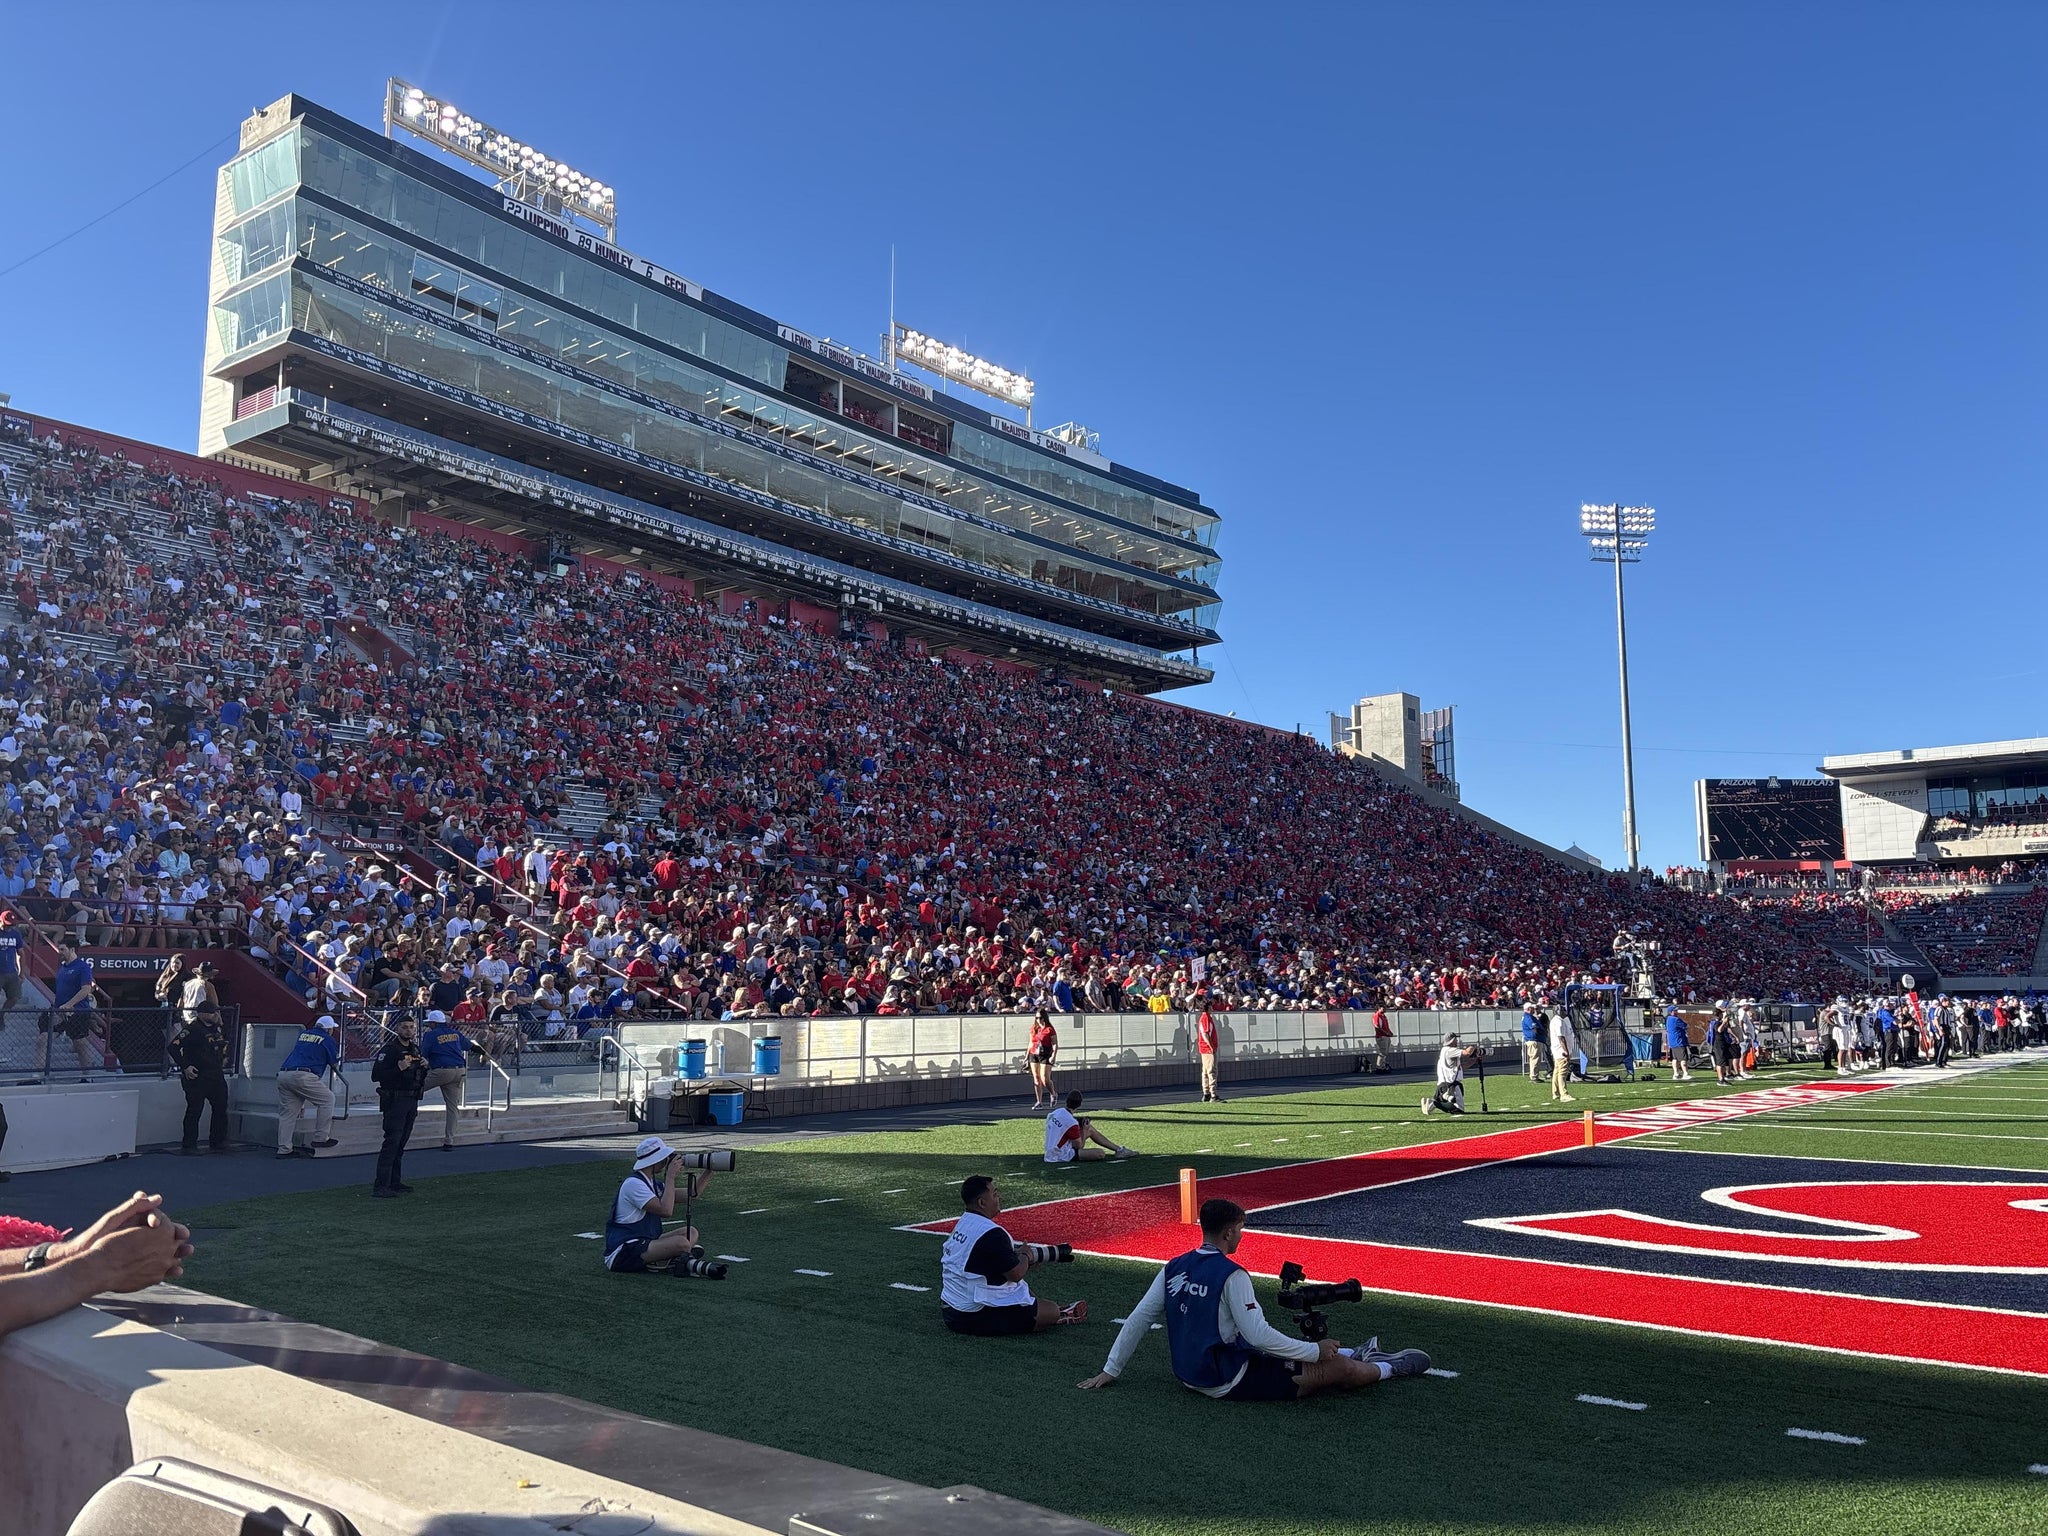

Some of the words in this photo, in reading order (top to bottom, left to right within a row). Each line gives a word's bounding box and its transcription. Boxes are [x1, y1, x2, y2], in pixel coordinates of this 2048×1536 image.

[507, 201, 522, 217] 22
[523, 209, 570, 241] LUPPINO
[578, 235, 593, 251] 89
[595, 241, 634, 270] HUNLEY
[314, 264, 334, 278] ROB
[335, 272, 393, 302] GRONKOWSKI
[646, 265, 654, 280] 6
[664, 274, 689, 297] CECIL
[396, 298, 429, 317] SCOOBY
[430, 311, 461, 329] WRIGHT
[465, 325, 492, 342] TRUNG
[491, 335, 528, 355] CANIDATE
[781, 328, 787, 339] 4
[791, 332, 812, 351] LEWIS
[312, 337, 330, 350] JOE
[332, 343, 384, 369] TOFFLEMIRE
[530, 351, 551, 366] KEITH
[550, 358, 573, 373] SMITH
[828, 347, 855, 369] BRUSCHI
[387, 363, 417, 381] DENNIS
[418, 375, 466, 399] NORTHCUTT
[866, 362, 892, 383] WALDROP
[471, 395, 489, 406] ROB
[488, 399, 526, 419] WALDROP
[4, 414, 31, 426] SECTION
[305, 409, 330, 426] DAVE
[331, 418, 369, 439] HIBBERT
[531, 415, 549, 428] TOM
[548, 421, 590, 442] TUNNICLIFFE
[1001, 421, 1031, 441] McALISTER
[371, 430, 396, 447] HANK
[396, 438, 437, 461] STANTON
[1036, 435, 1041, 446] 5
[1046, 439, 1067, 456] CASON
[438, 452, 461, 467] WALT
[461, 460, 495, 478] NIELSEN
[500, 471, 521, 486] TONY
[521, 477, 545, 493] BOUIE
[549, 487, 573, 503] ALLAN
[573, 495, 603, 512] DURDEN
[605, 505, 634, 521] HAROLD
[632, 513, 671, 533] McCLELLON
[672, 525, 692, 539] EDDIE
[691, 531, 717, 546] WILSON
[719, 540, 731, 551] TED
[731, 544, 752, 558] BLAND
[755, 550, 769, 562] TOM
[768, 555, 801, 572] GREENFIELD
[803, 565, 816, 575] ART
[814, 568, 838, 582] LUPPINO
[841, 576, 859, 588] JACKIE
[858, 581, 882, 595] WALLACE
[1718, 779, 1757, 787] ARIZONA
[1791, 779, 1835, 787] WILDCATS
[1849, 788, 1920, 800] LOWELL-STEVENS
[342, 840, 351, 848] 17
[385, 843, 395, 851] 18
[99, 959, 149, 970] SECTION
[152, 957, 169, 971] 17
[299, 1031, 325, 1046] SECURITY
